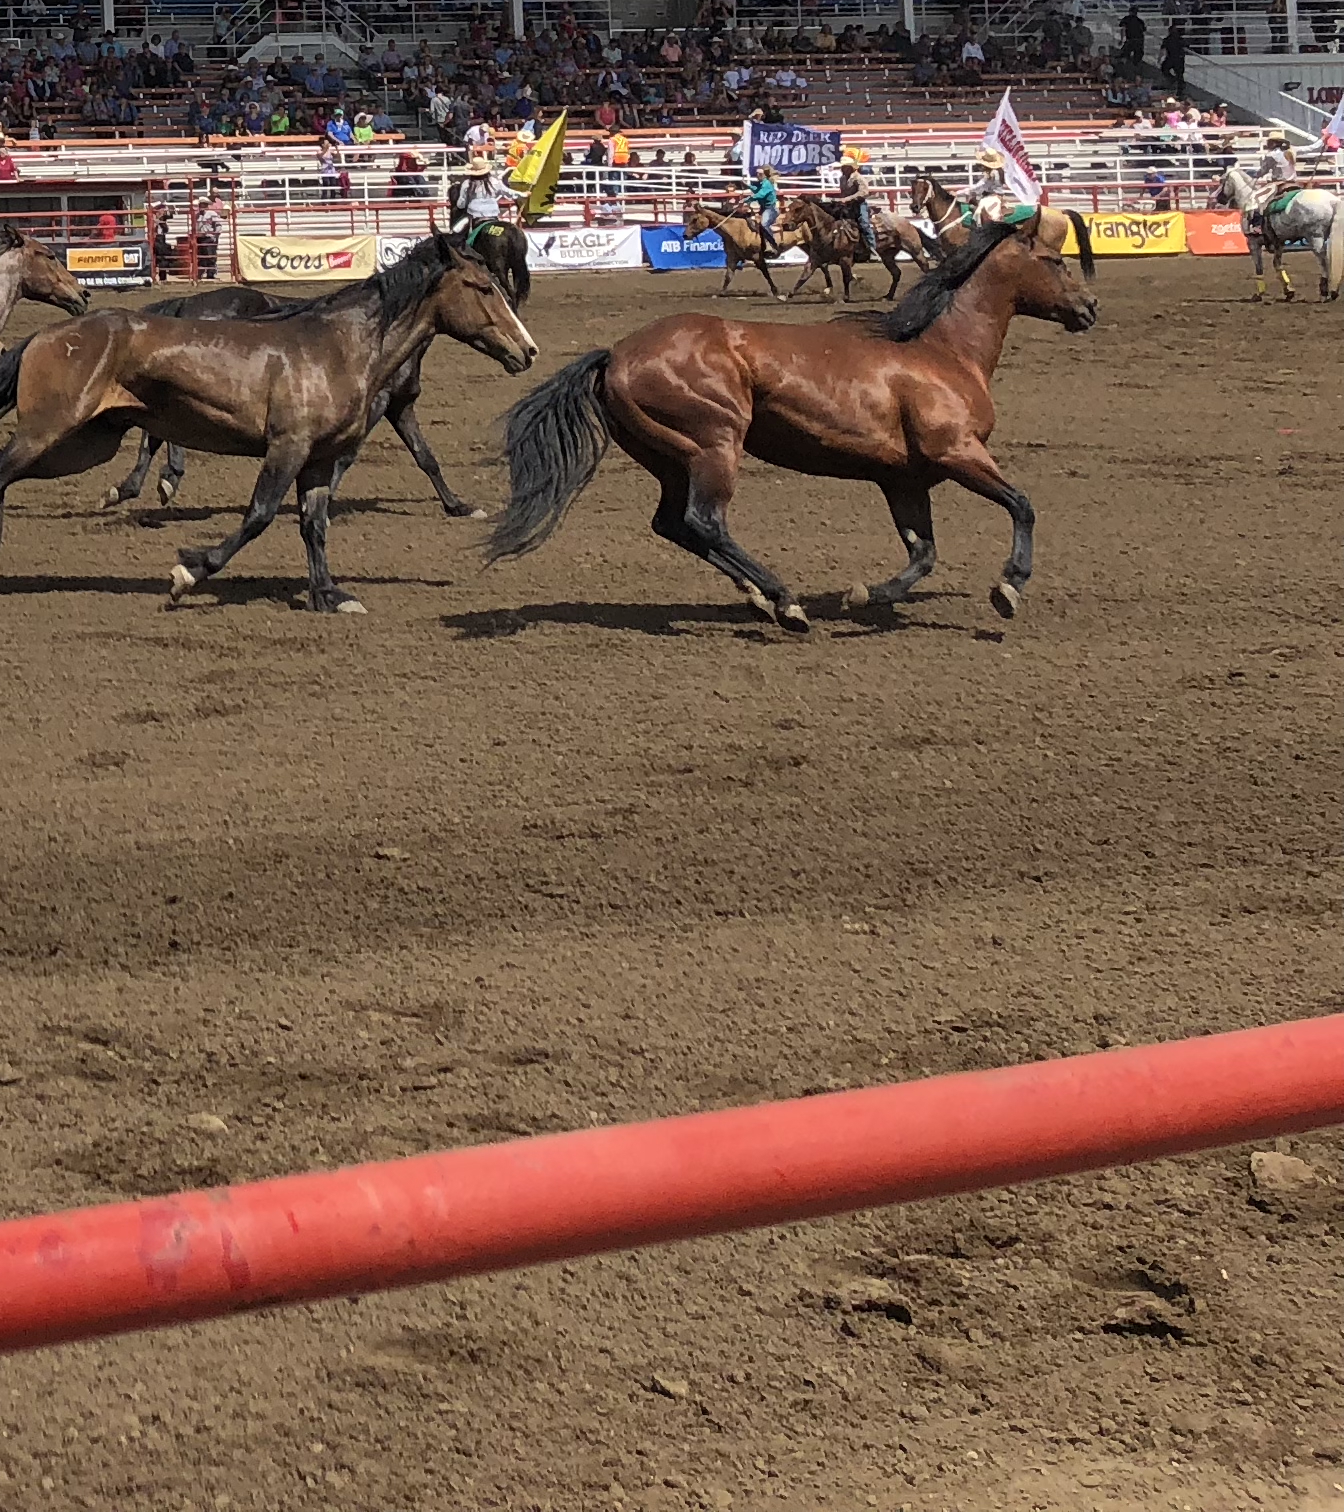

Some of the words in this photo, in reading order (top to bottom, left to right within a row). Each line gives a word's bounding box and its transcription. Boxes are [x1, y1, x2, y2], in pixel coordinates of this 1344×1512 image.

[759, 130, 787, 143] RED
[753, 143, 836, 167] MOTORS
[661, 241, 681, 252] ATB
[260, 246, 324, 270] Coors
